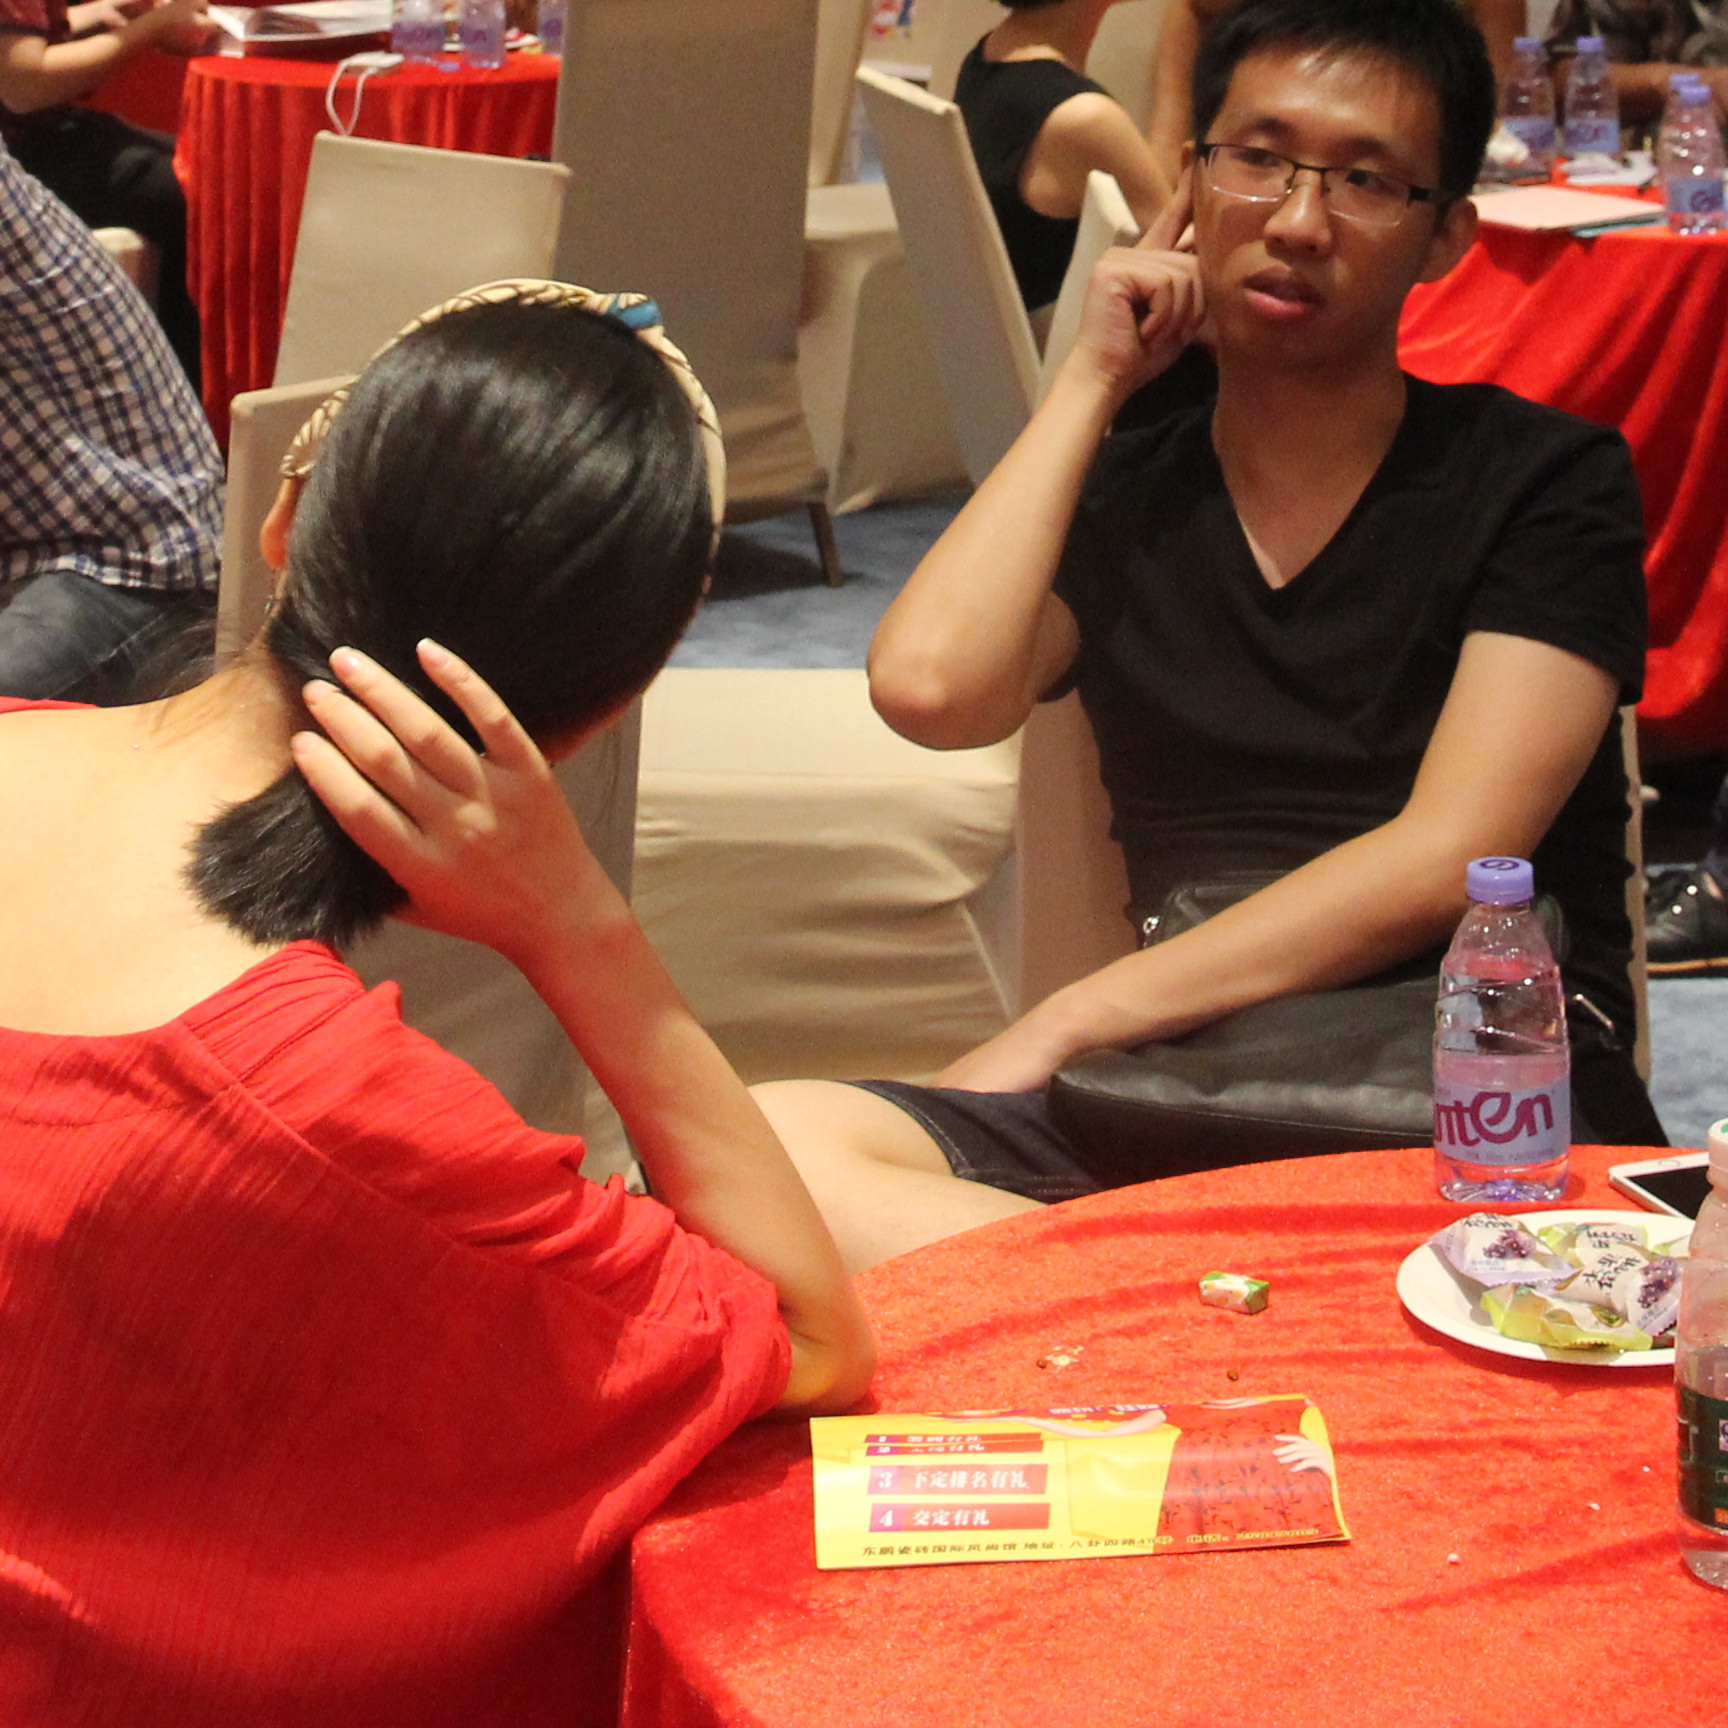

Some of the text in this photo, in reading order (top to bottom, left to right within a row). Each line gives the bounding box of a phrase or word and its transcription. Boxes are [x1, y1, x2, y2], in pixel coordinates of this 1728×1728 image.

[878, 1469, 1030, 1490] 3 下定排名有礼
[879, 1508, 990, 1527] 4 交定有礼
